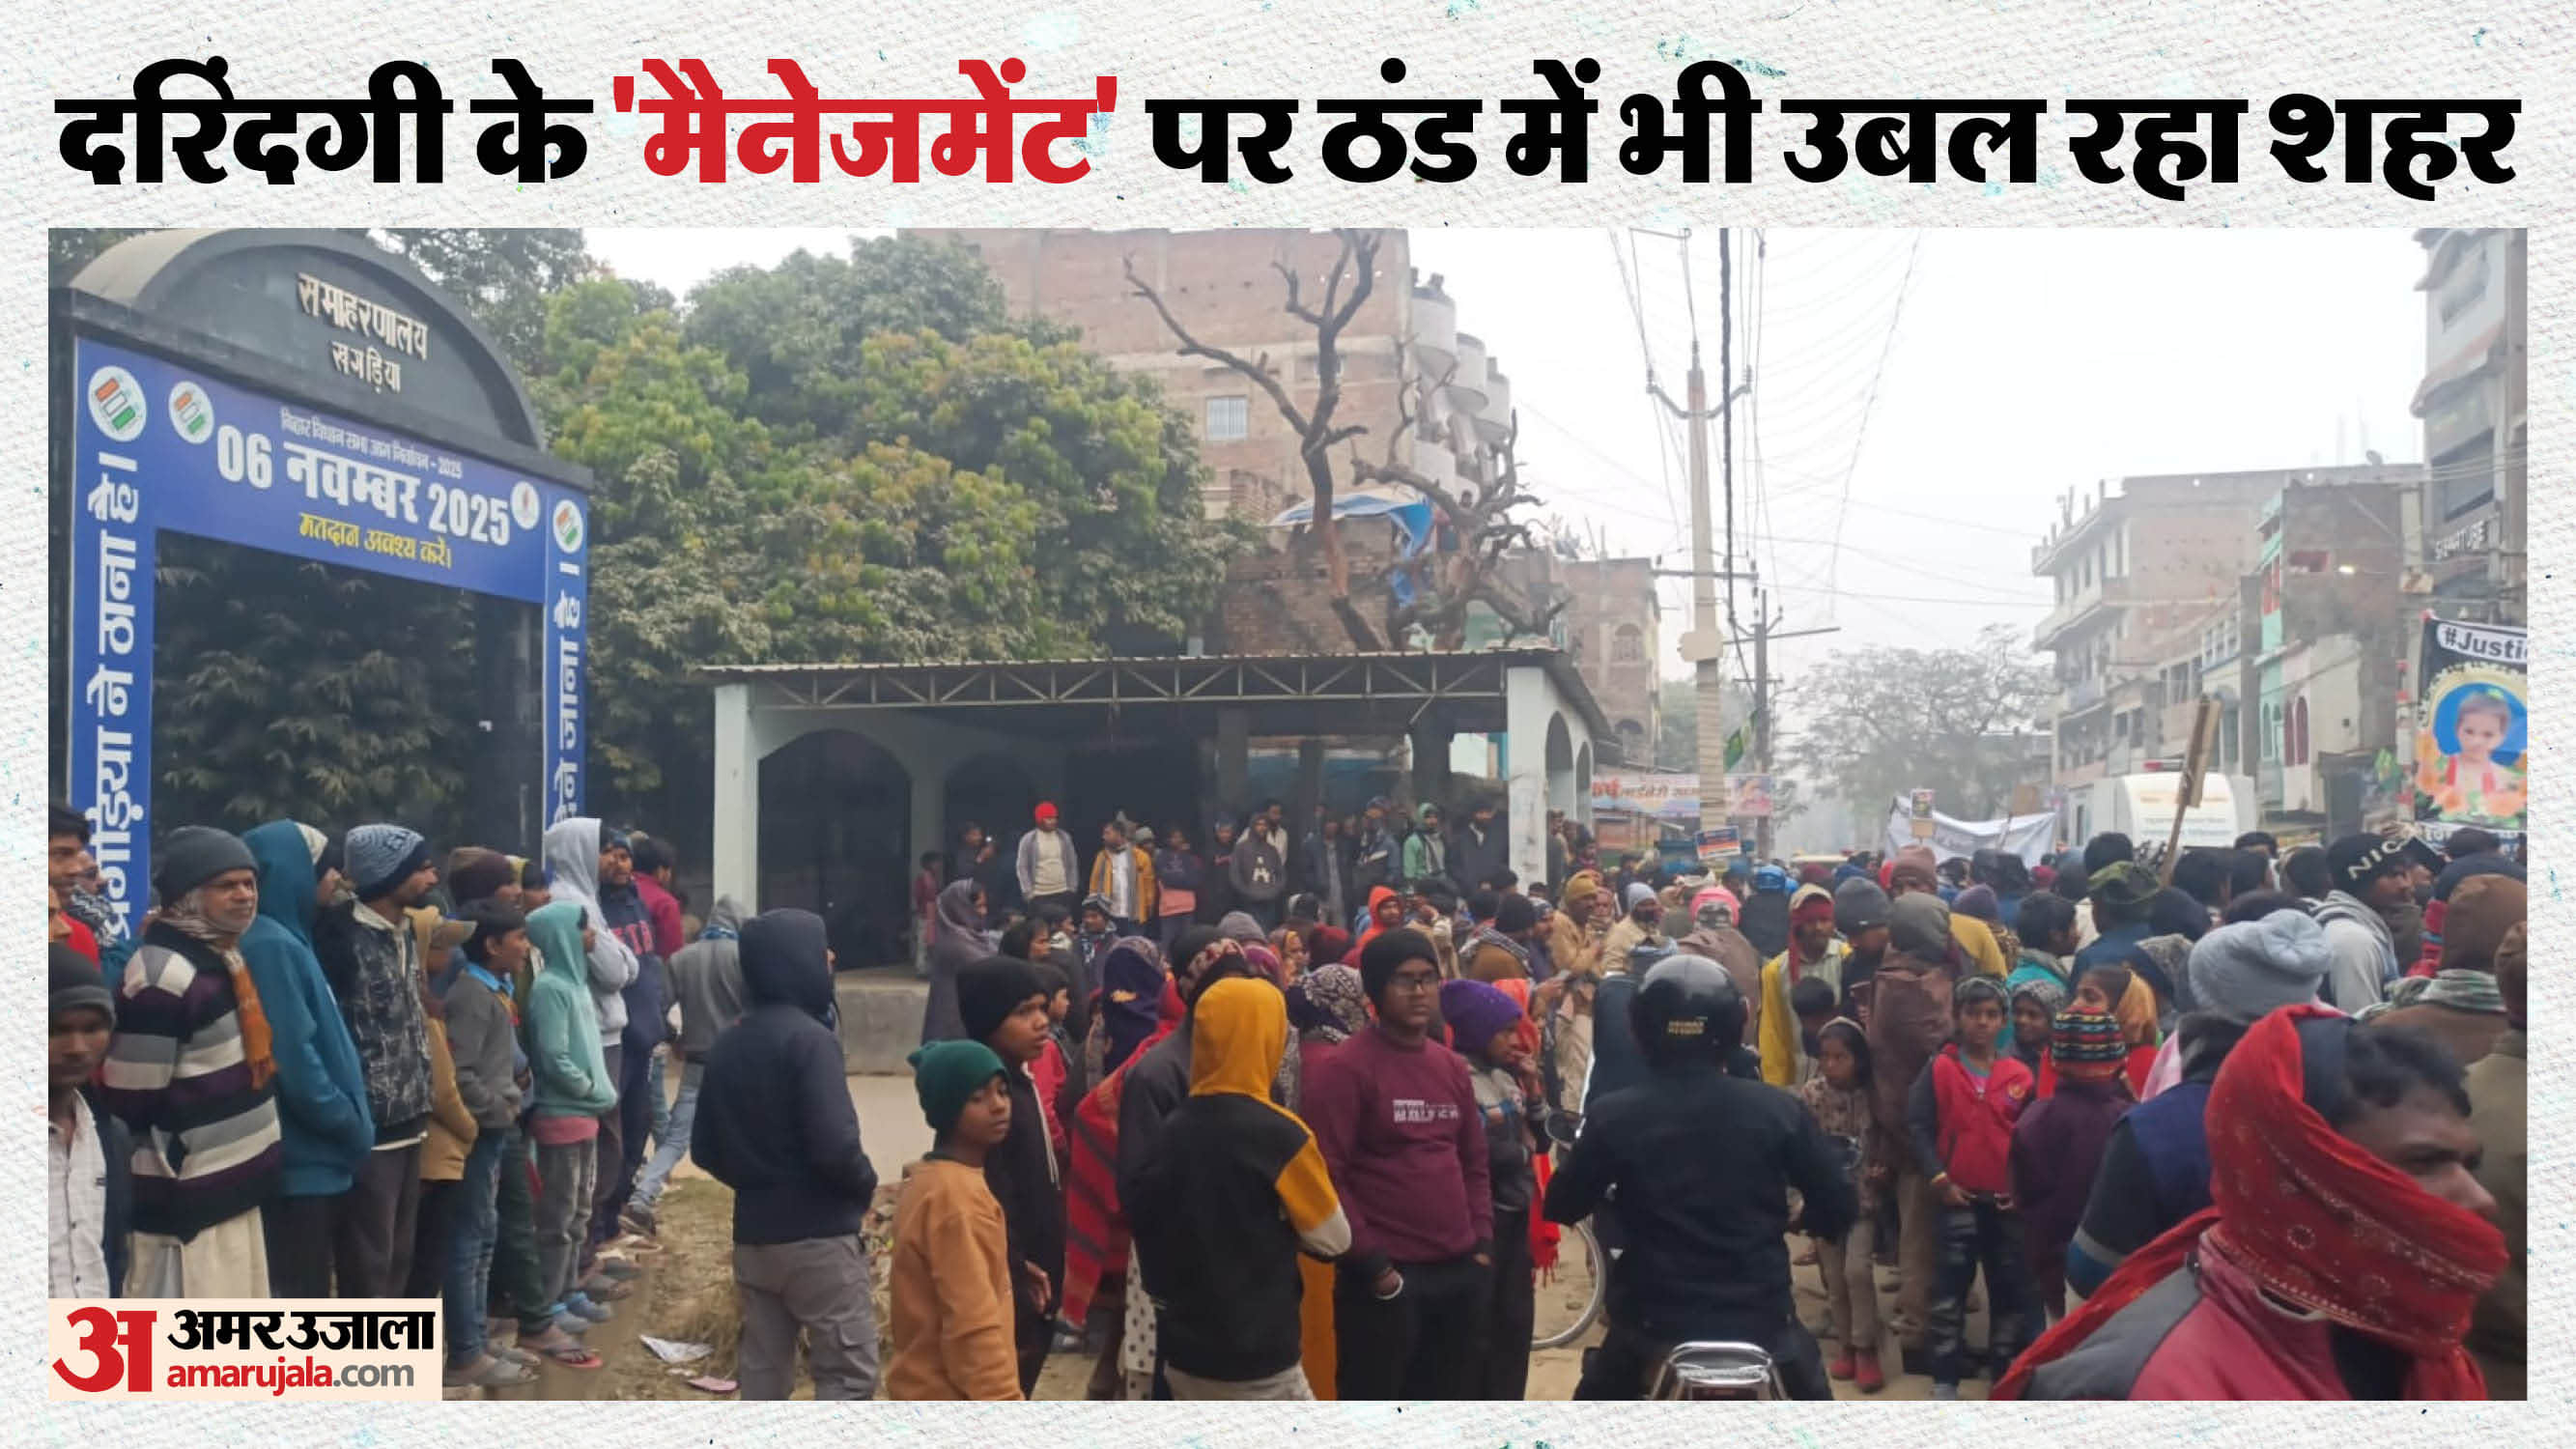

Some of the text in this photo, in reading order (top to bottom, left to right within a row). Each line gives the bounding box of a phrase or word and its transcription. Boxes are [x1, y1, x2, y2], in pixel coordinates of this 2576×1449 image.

[297, 271, 428, 360] समाहरणालय
[217, 424, 510, 546] 06 नवम्बर 2025
[298, 512, 360, 549] मतदान
[363, 529, 417, 560] अवश्य
[99, 528, 137, 655] ठाना
[2444, 626, 2527, 660] #Justi
[86, 664, 134, 719] ने
[559, 637, 580, 751] जाना
